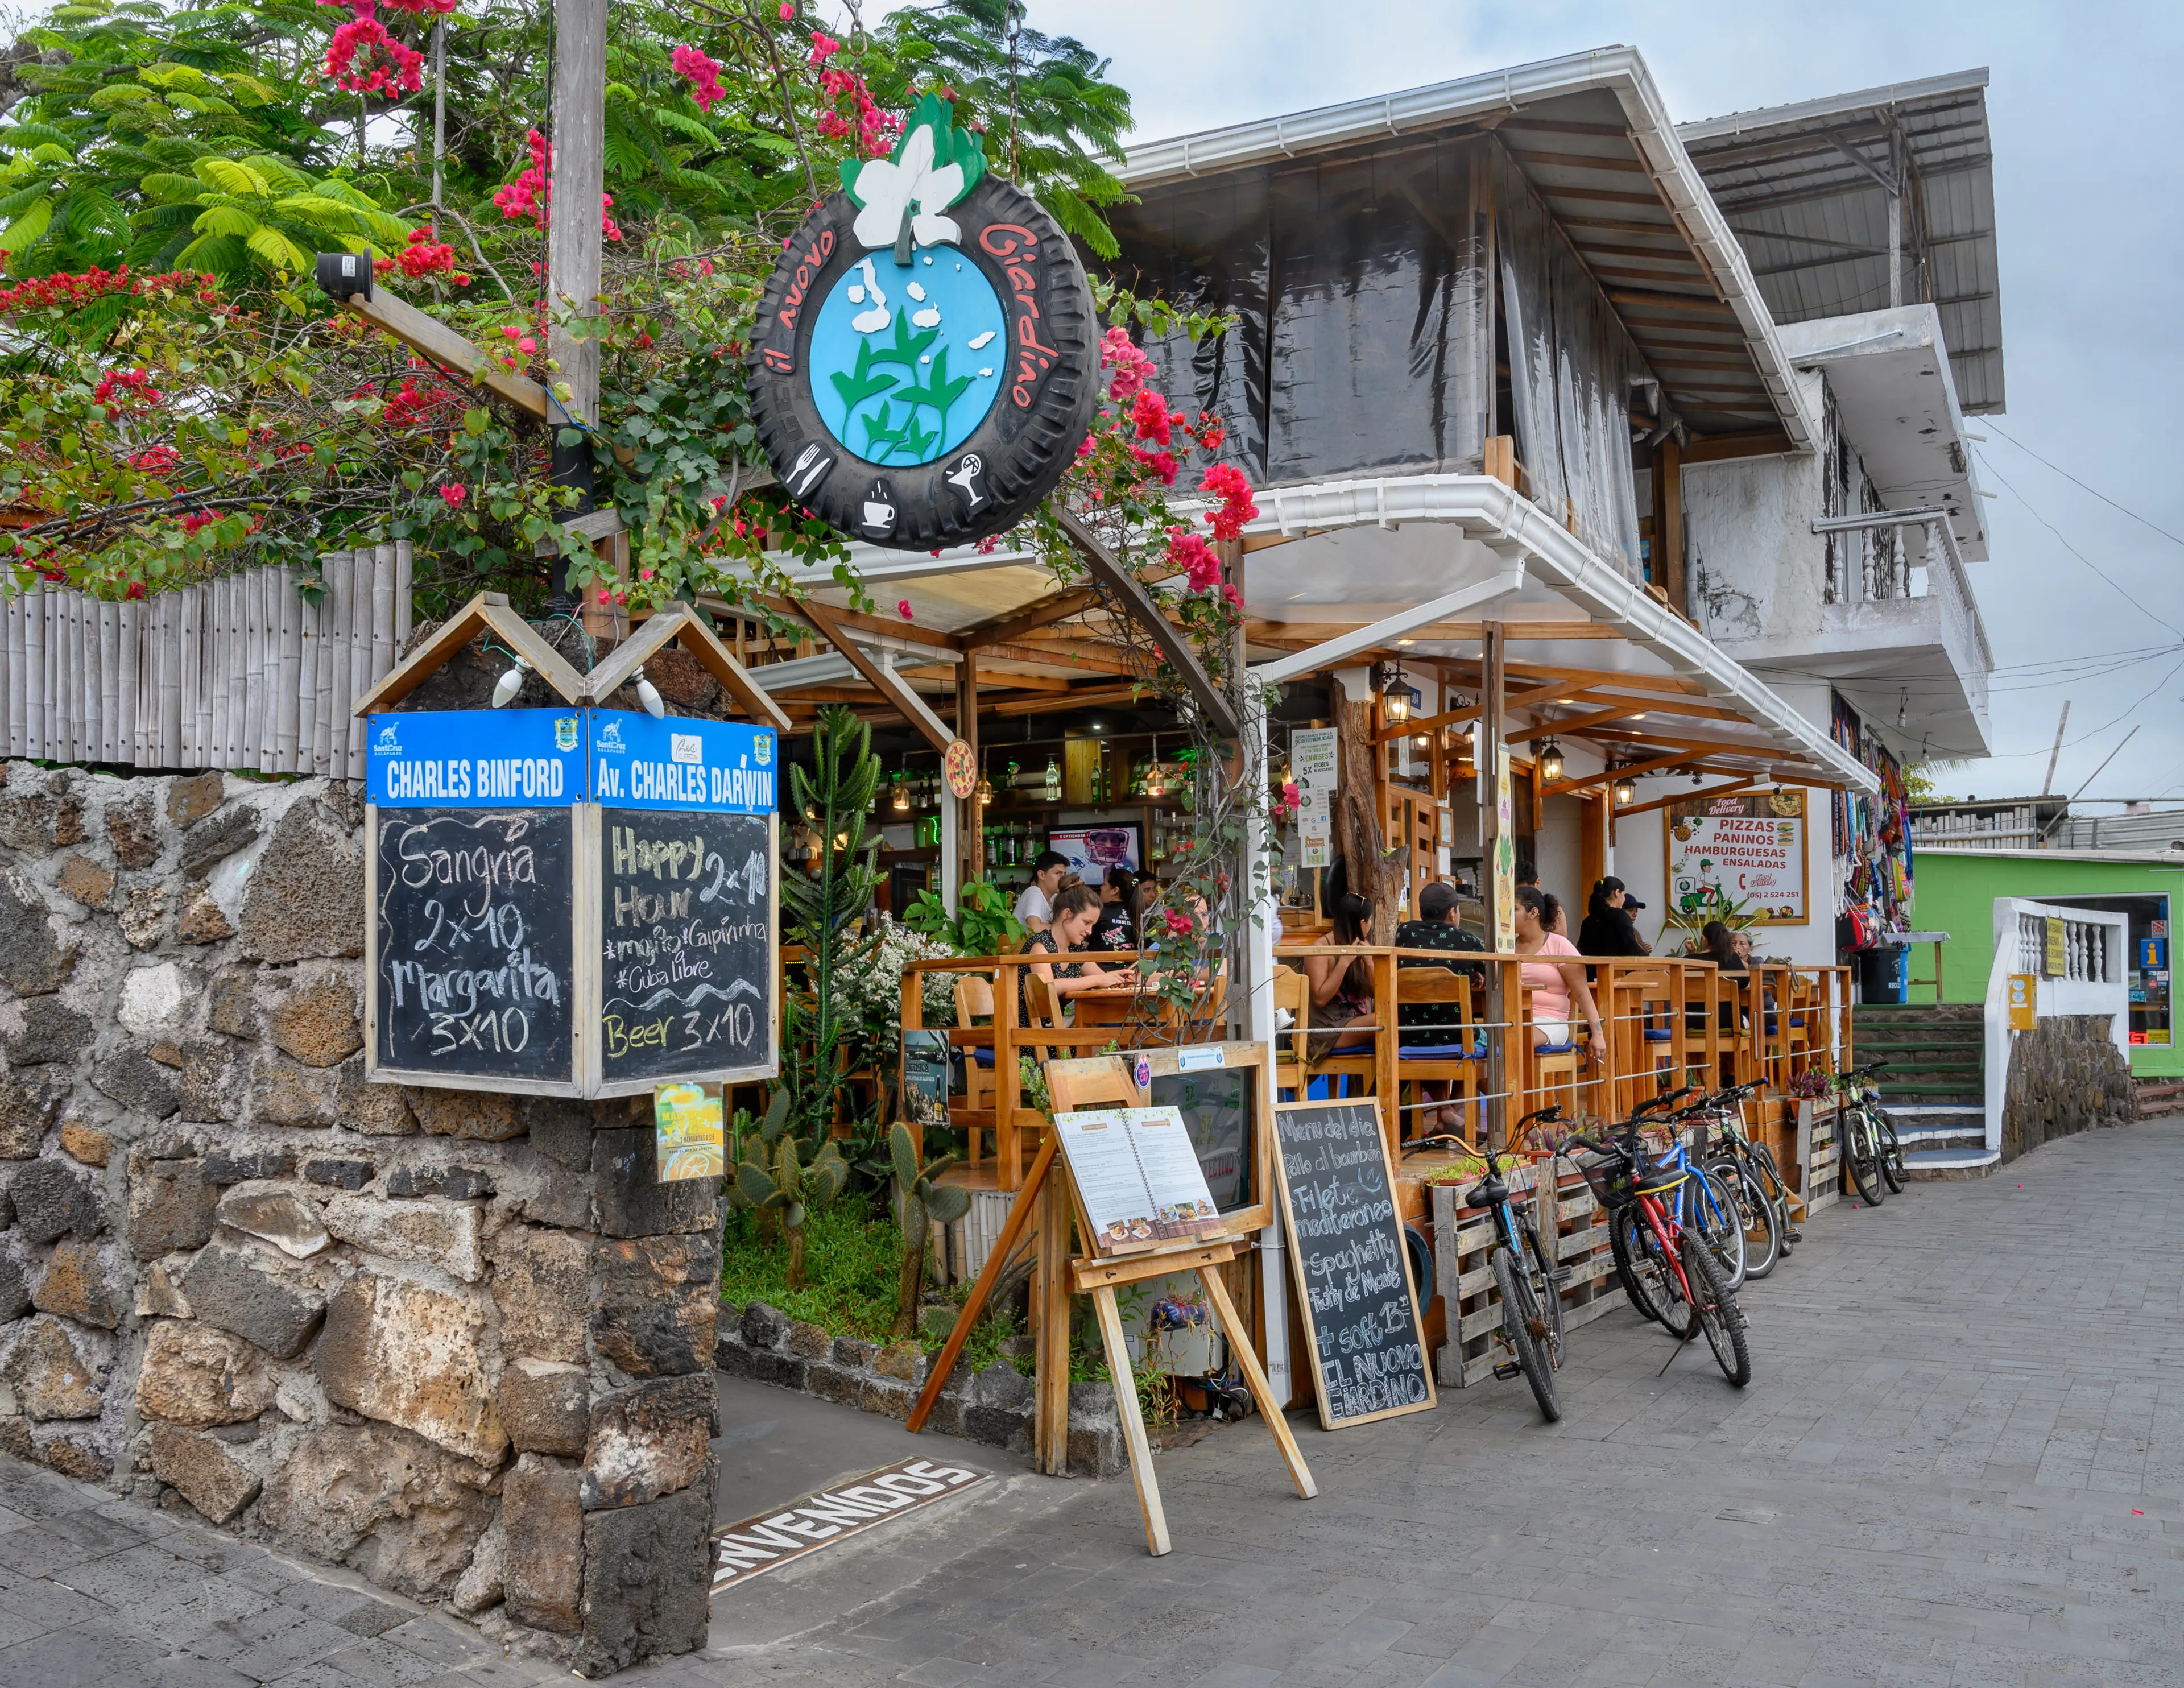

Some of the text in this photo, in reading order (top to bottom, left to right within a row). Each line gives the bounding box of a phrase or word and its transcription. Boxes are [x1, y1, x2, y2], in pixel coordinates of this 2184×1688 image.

[979, 224, 1059, 408] Giardino
[1302, 766, 1312, 775] 5%
[1305, 753, 1329, 762] ENVASES
[387, 758, 563, 799] CHARLES BINFORD
[597, 758, 772, 806] Av. CHARLES DARWIN
[1709, 803, 1745, 816] Delivery
[1716, 797, 1738, 806] Food
[1713, 833, 1774, 846] PANINOS
[1719, 819, 1775, 832] PIZZAS
[612, 826, 705, 881] Happy
[1685, 845, 1786, 858] HAMBURGUESAS
[1723, 858, 1786, 869] ENSALADAS
[1750, 878, 1776, 887] Delivery
[614, 885, 693, 928] Hour
[602, 1015, 675, 1058] Beer
[1277, 1111, 1323, 1142] Menu
[1324, 1108, 1347, 1140] del
[1283, 1152, 1312, 1179] Pollo
[1315, 1145, 1330, 1171] al
[1309, 1228, 1399, 1285] Spaghetty
[1345, 1272, 1361, 1302] de
[1321, 1359, 1352, 1389] IL
[1353, 1343, 1423, 1383] NUOVO
[714, 1460, 978, 1583] NVENIDOS
